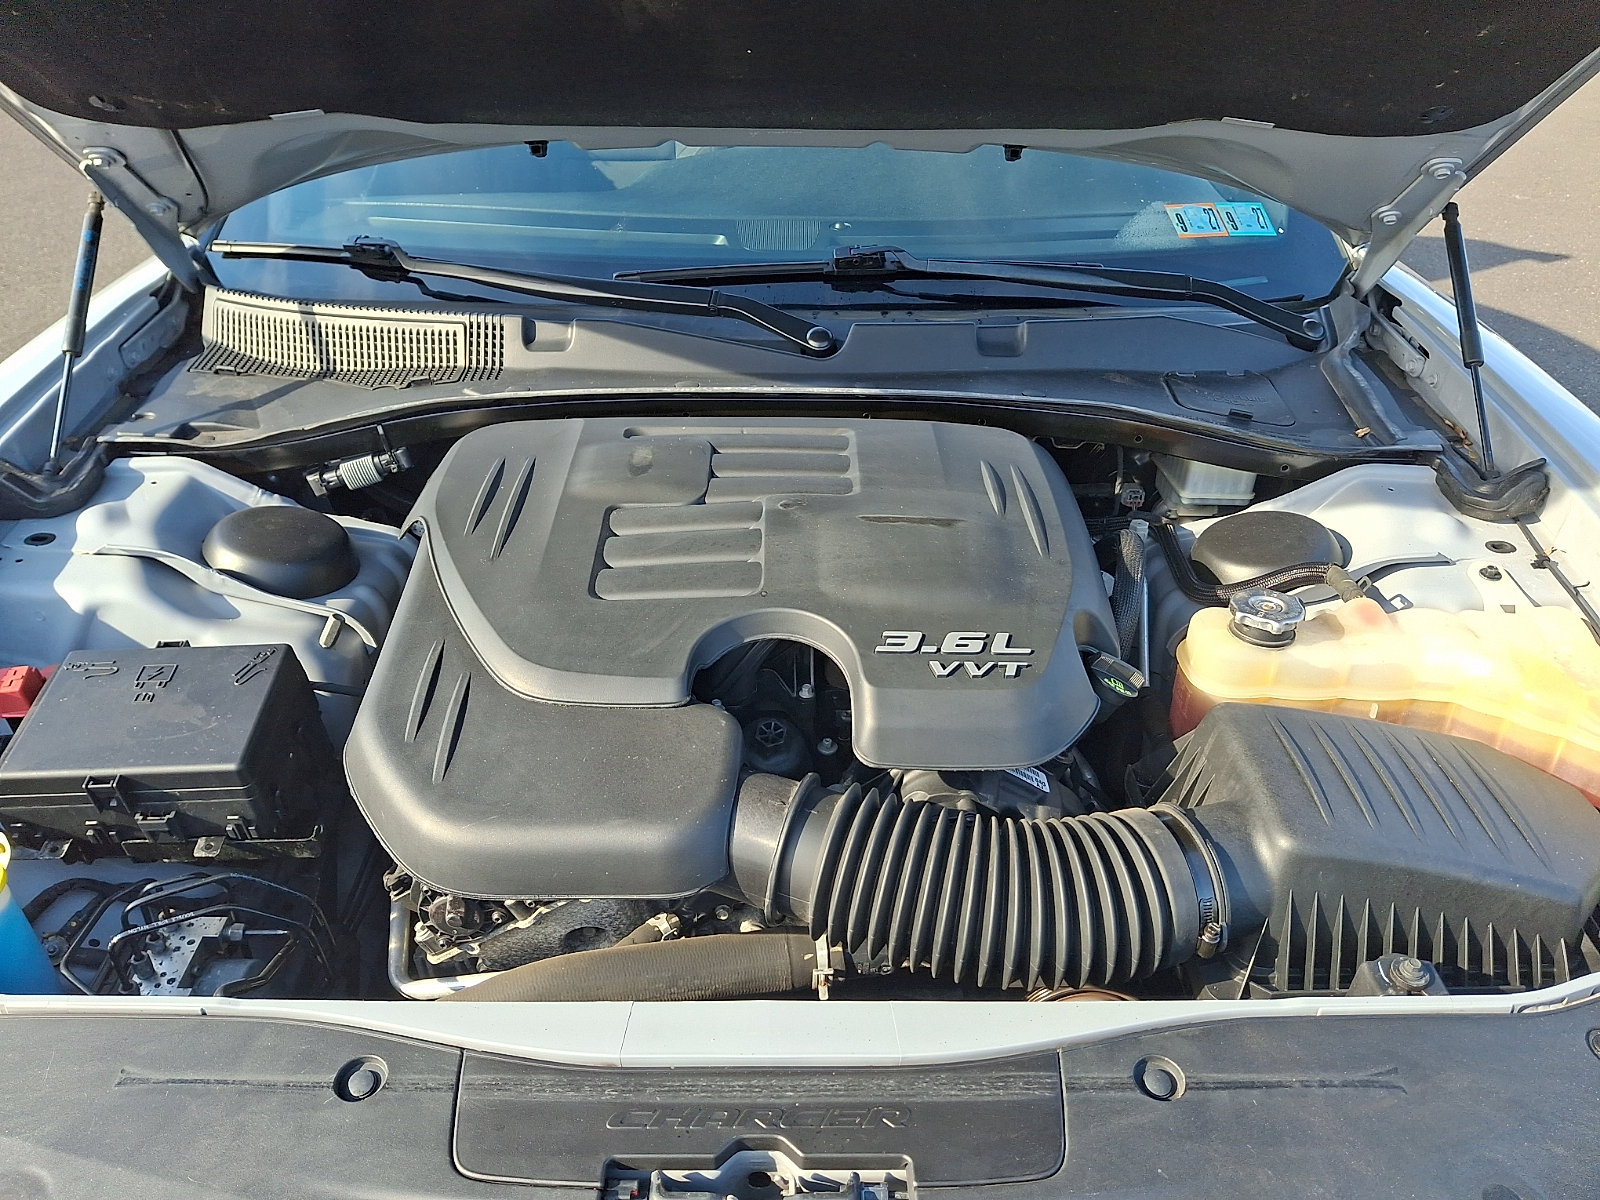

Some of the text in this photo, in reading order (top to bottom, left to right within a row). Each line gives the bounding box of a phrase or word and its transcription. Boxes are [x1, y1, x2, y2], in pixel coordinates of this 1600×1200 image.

[1175, 213, 1188, 232] 9
[1203, 207, 1221, 231] 27
[1226, 211, 1239, 231] 9
[1251, 207, 1268, 230] 27
[875, 631, 1035, 655] 3.6L
[928, 660, 1032, 679] VVT
[605, 1107, 911, 1129] CHARGER
